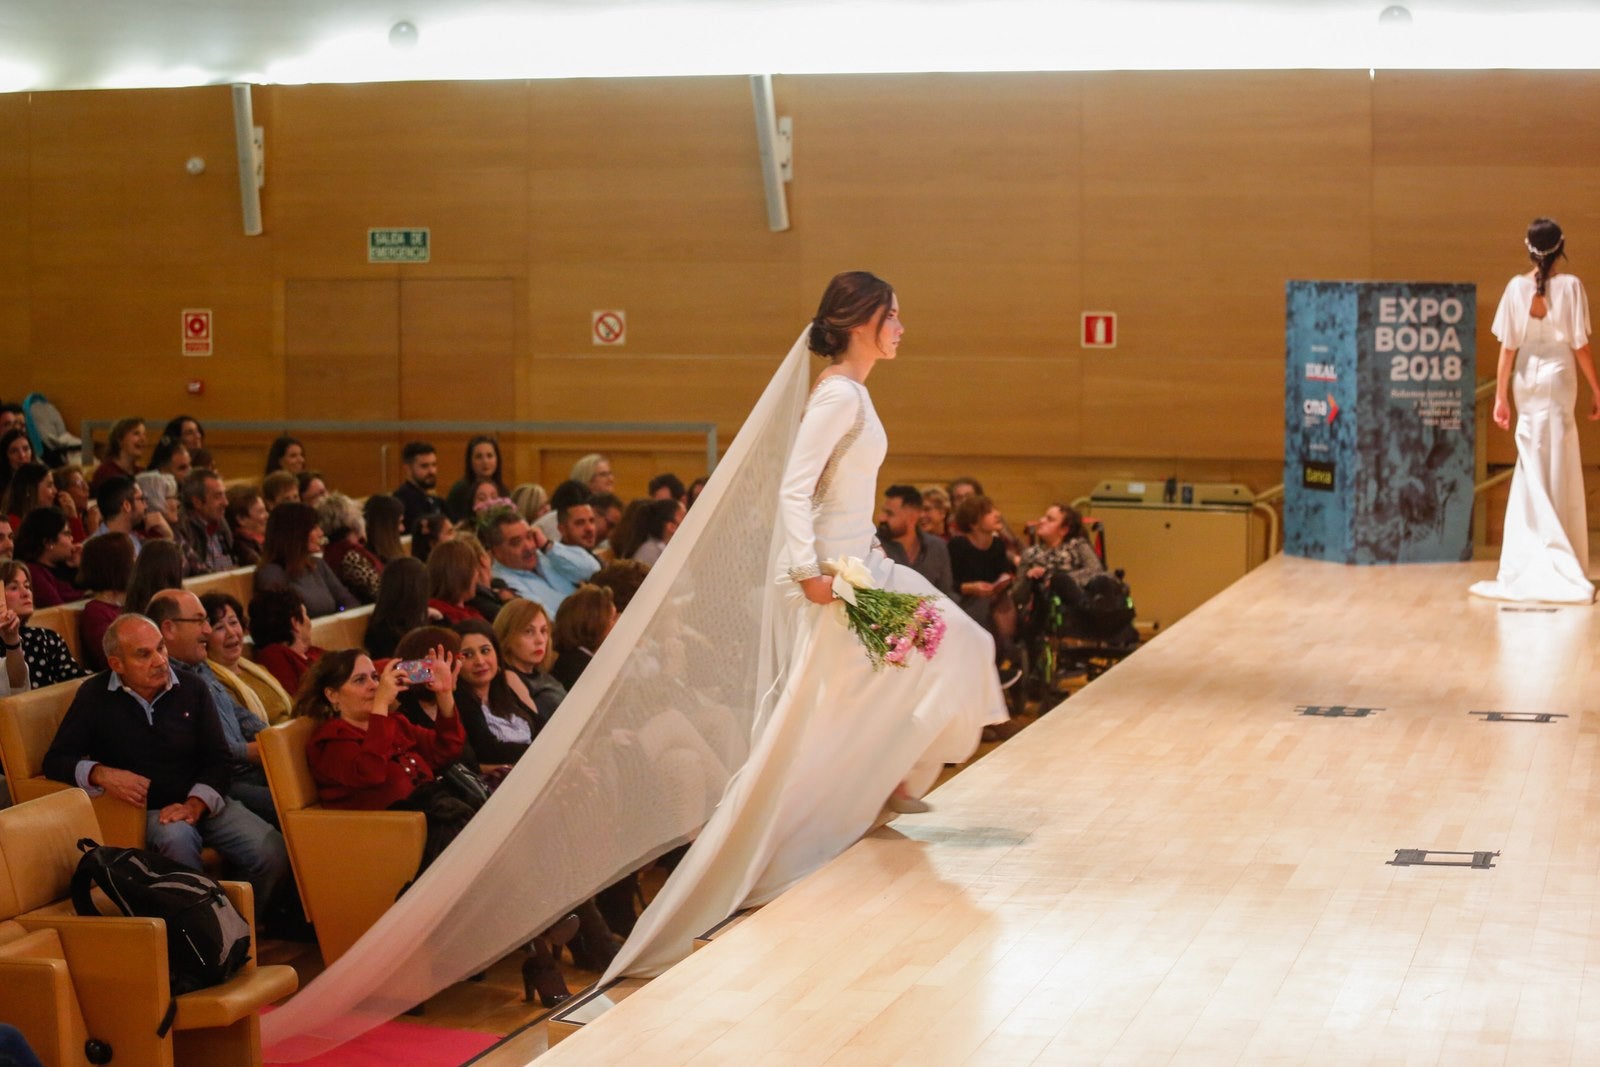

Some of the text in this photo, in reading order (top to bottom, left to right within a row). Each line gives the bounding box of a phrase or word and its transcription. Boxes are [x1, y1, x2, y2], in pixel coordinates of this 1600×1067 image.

[1379, 296, 1463, 324] EXPO
[1375, 326, 1462, 353] BODA
[1390, 355, 1462, 382] 2018
